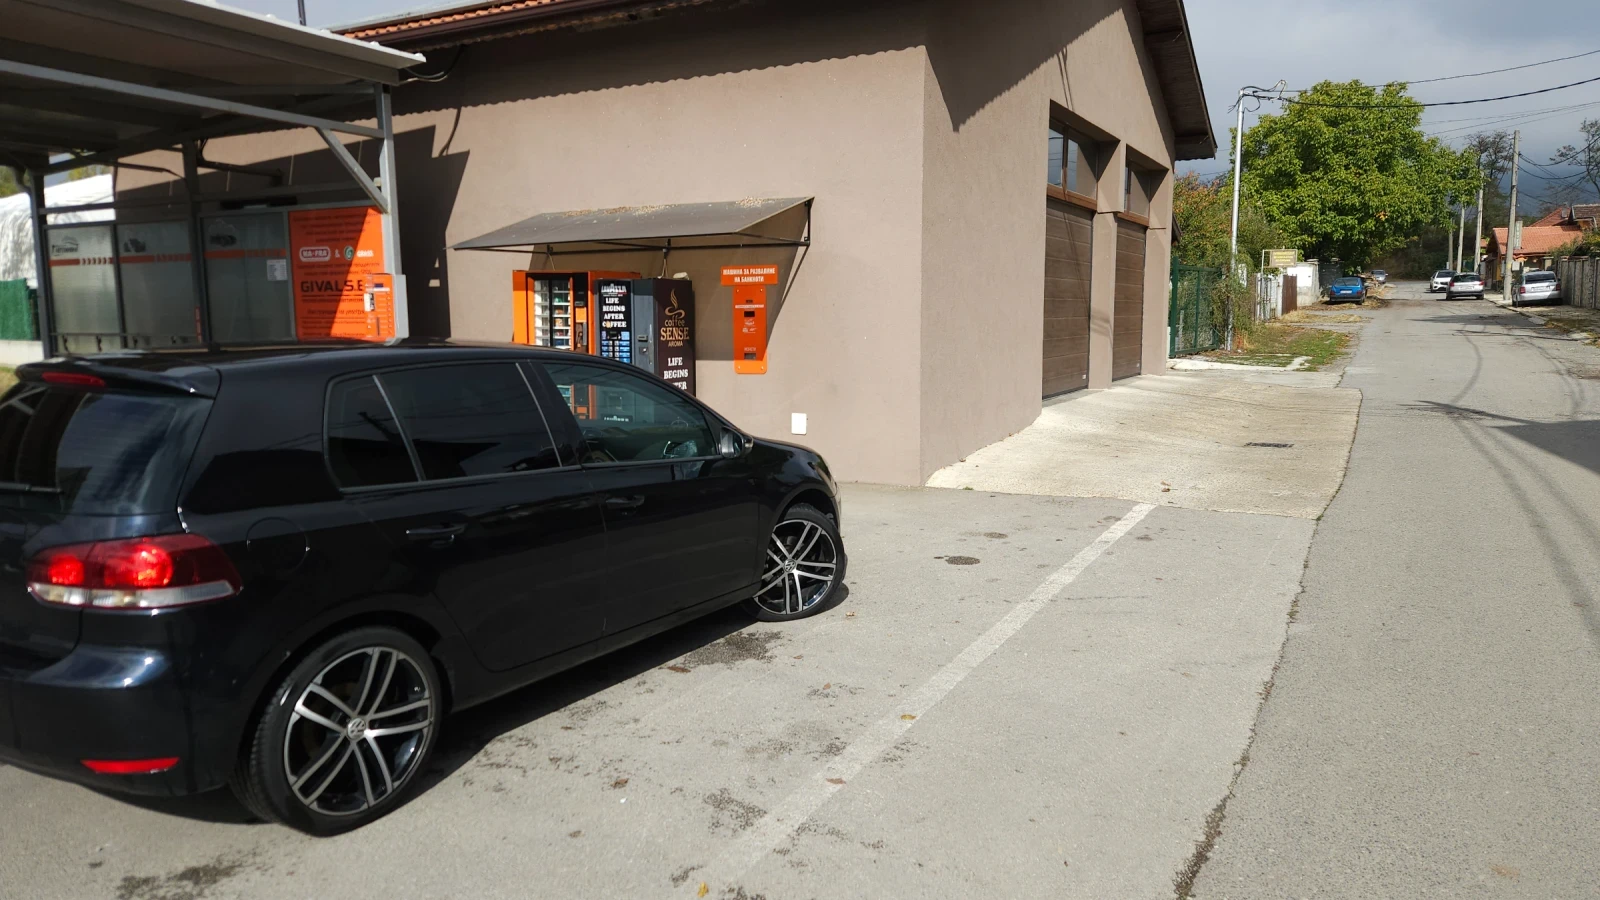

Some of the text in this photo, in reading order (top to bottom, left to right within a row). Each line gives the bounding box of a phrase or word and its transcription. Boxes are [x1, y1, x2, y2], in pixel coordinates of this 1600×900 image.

[660, 327, 690, 341] SENSE
[667, 356, 683, 367] LIFE
[663, 369, 688, 379] BEGINS
